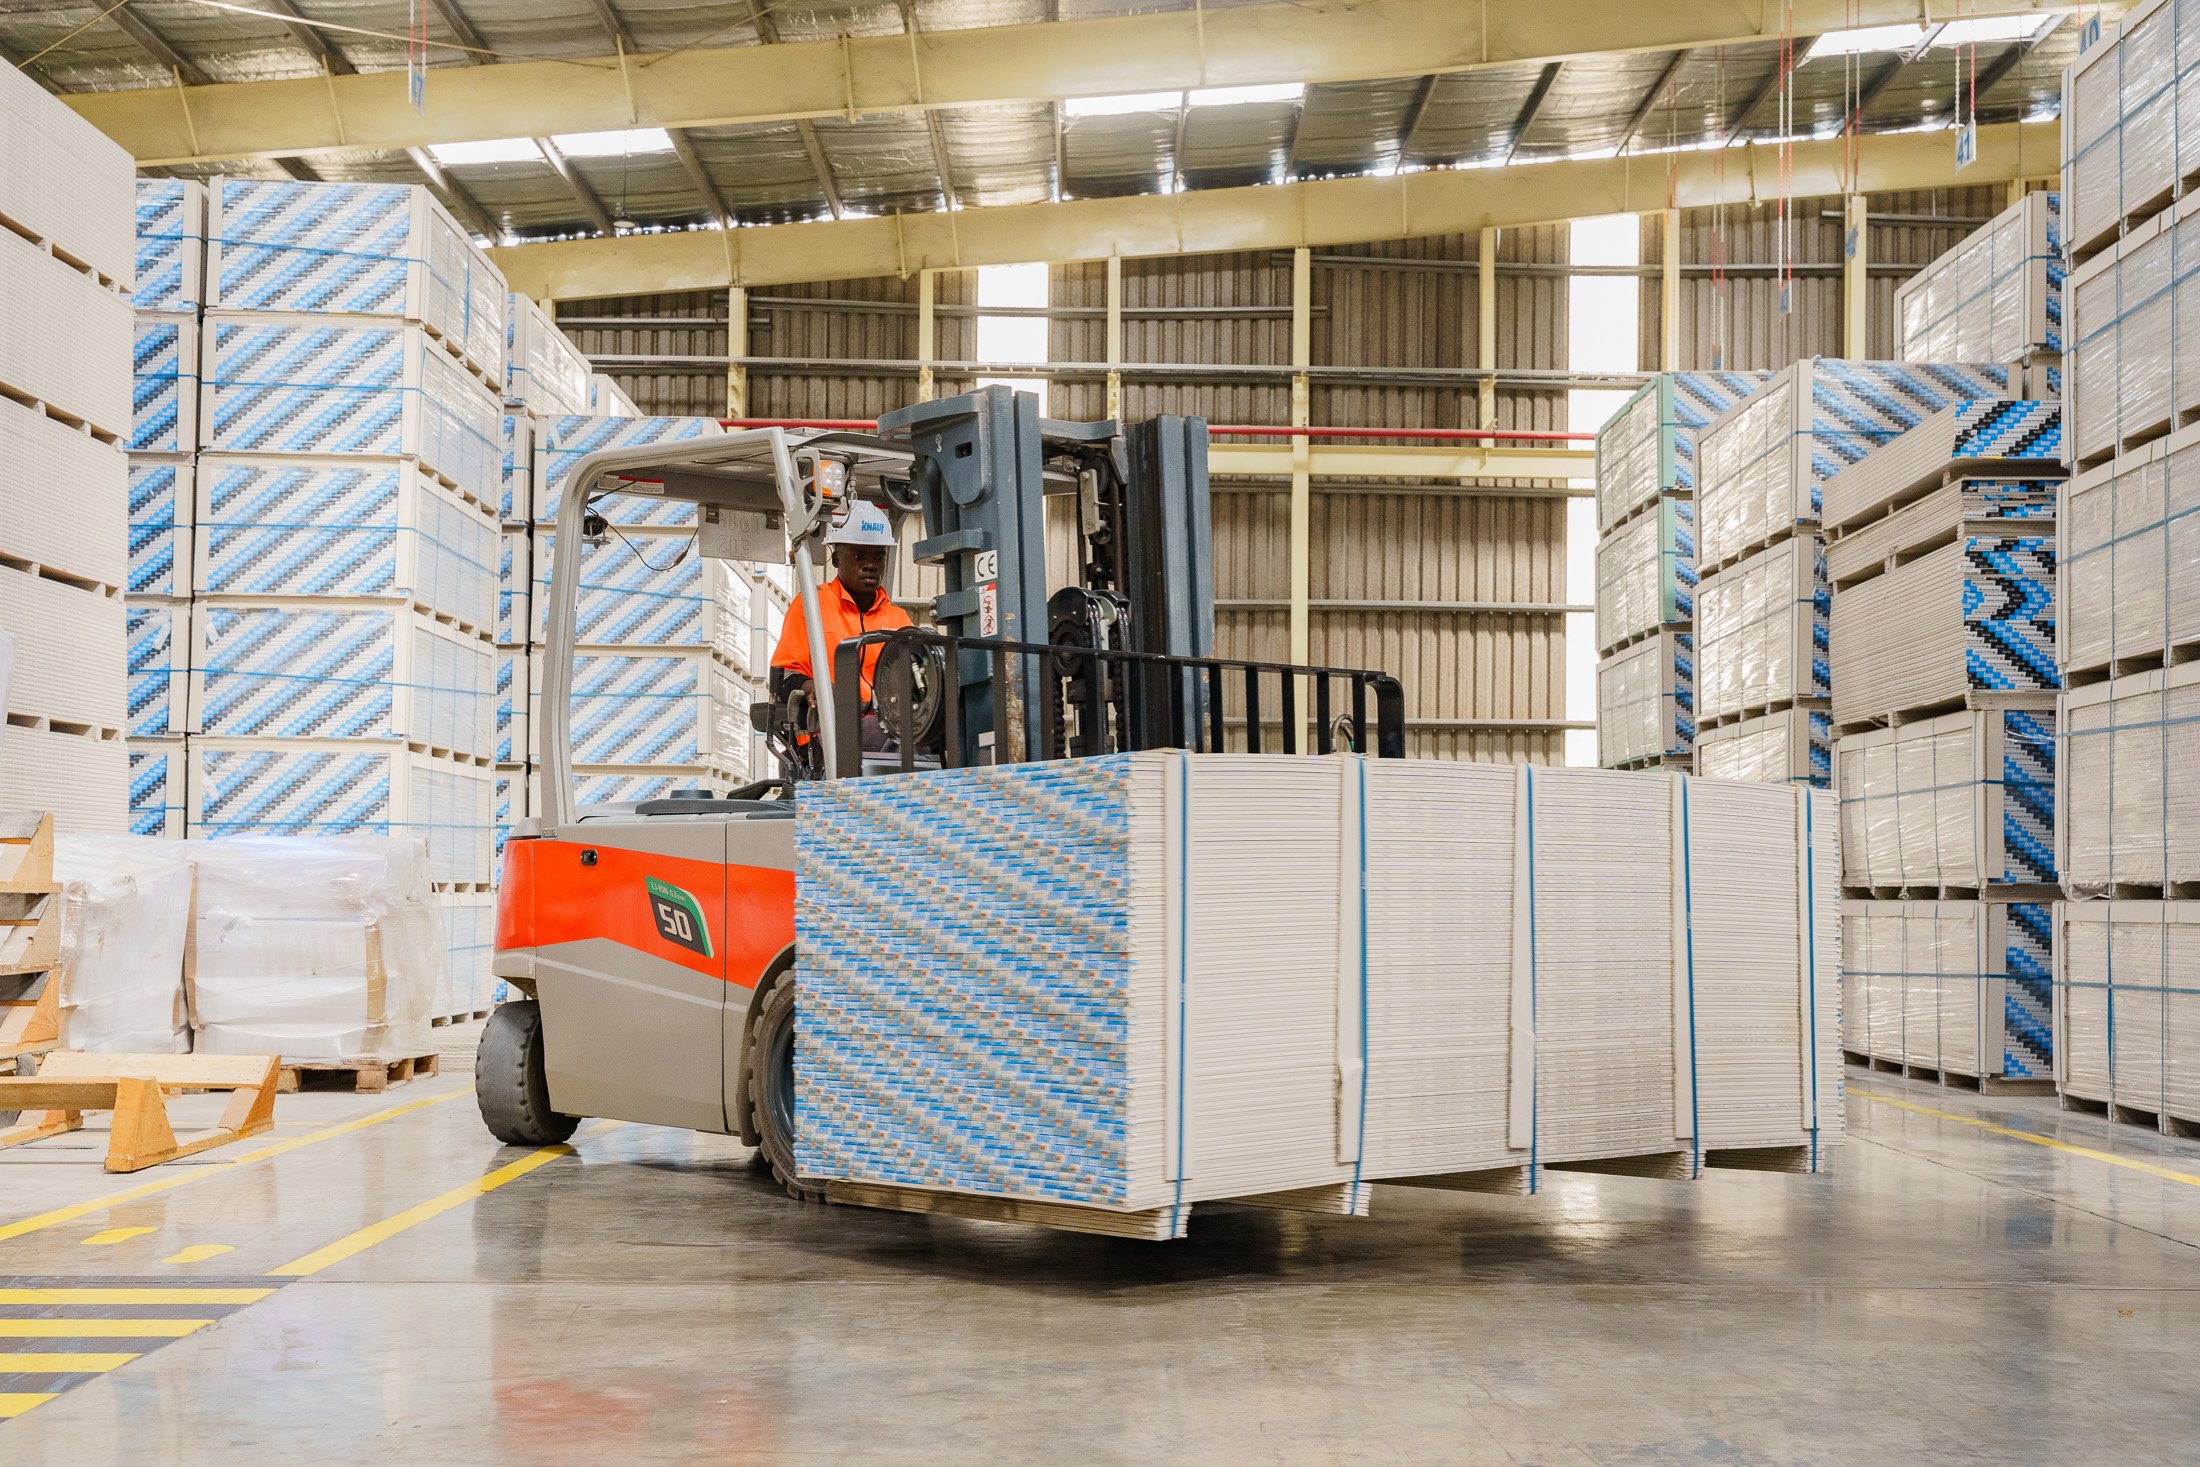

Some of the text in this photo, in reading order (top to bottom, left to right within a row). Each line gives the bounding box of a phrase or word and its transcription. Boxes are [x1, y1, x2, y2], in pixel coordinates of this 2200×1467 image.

[1957, 130, 1970, 165] 41
[861, 520, 885, 534] KNAUF
[977, 554, 995, 577] CE
[657, 902, 693, 942] 50
